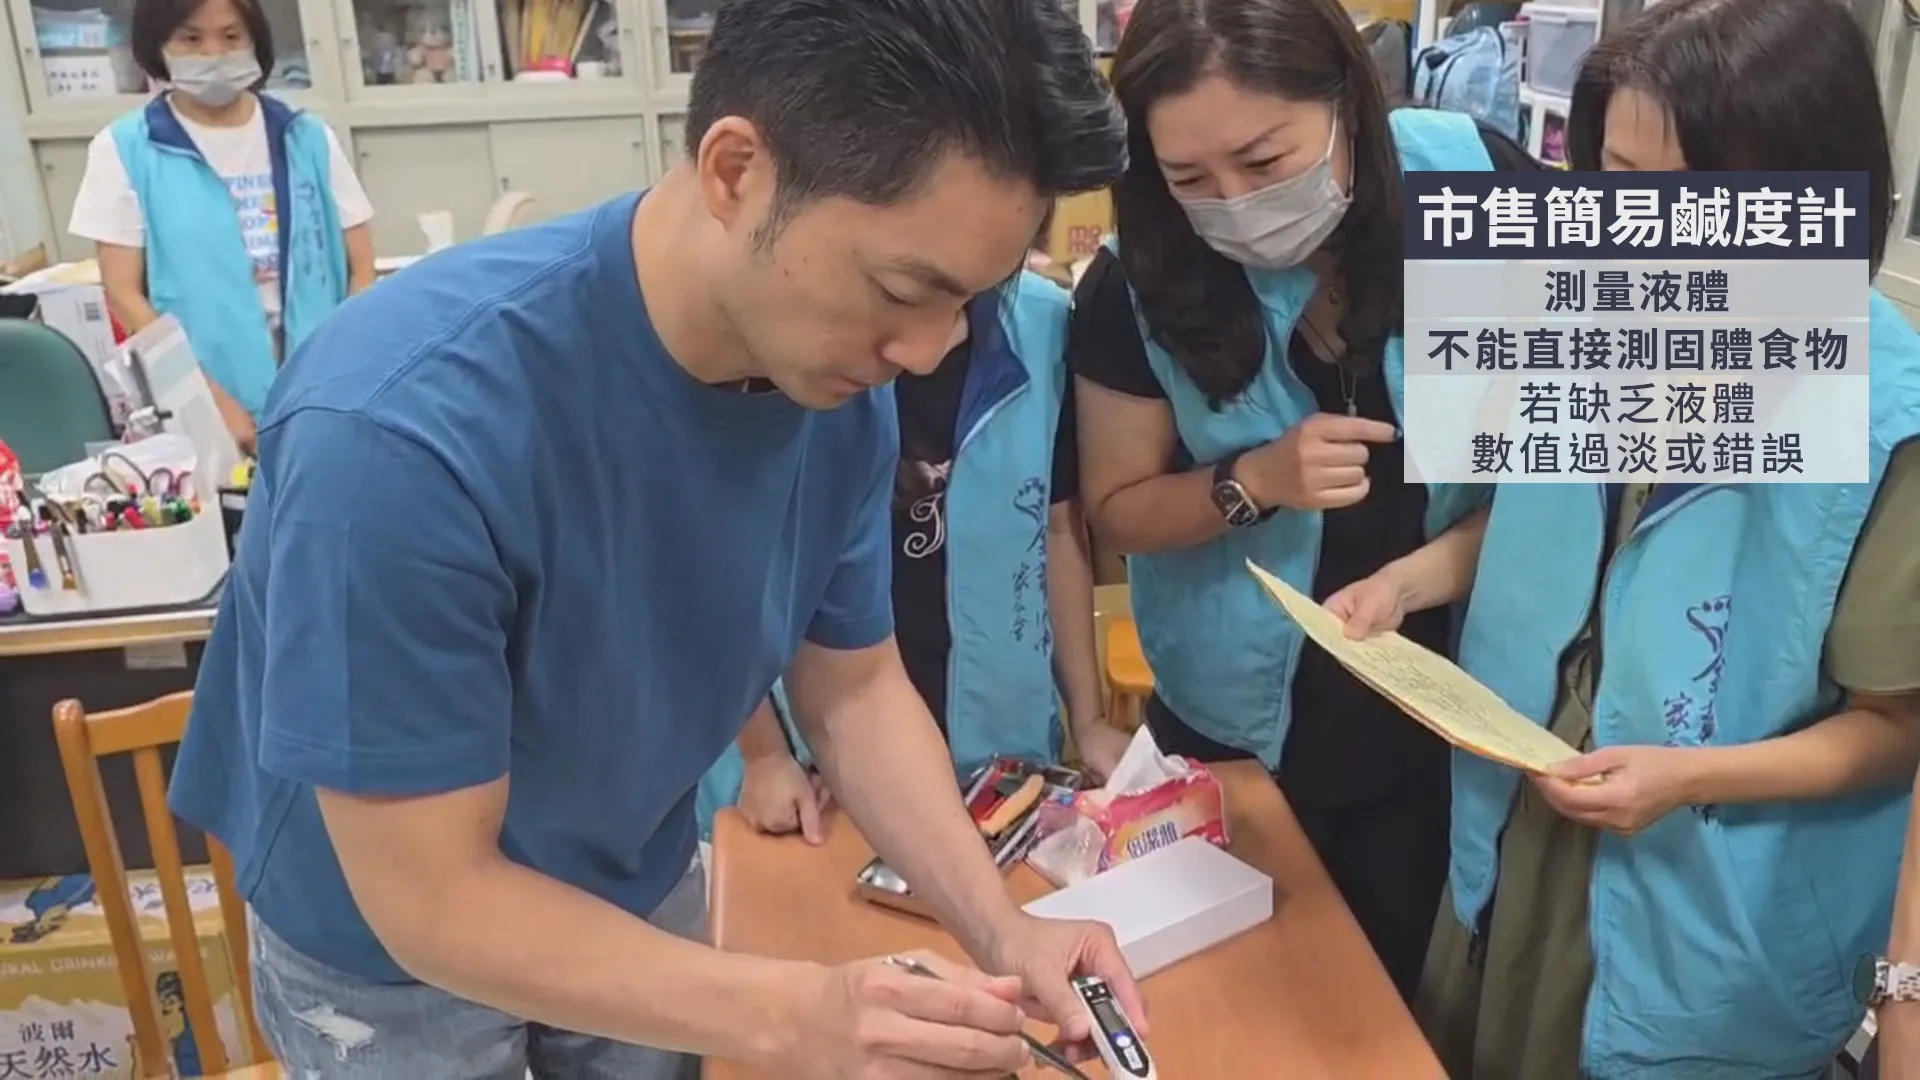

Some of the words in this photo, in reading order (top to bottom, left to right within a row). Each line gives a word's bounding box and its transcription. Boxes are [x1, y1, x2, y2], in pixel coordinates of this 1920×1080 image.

[19, 1019, 74, 1044] 波爾
[0, 1041, 118, 1080] 天然水
